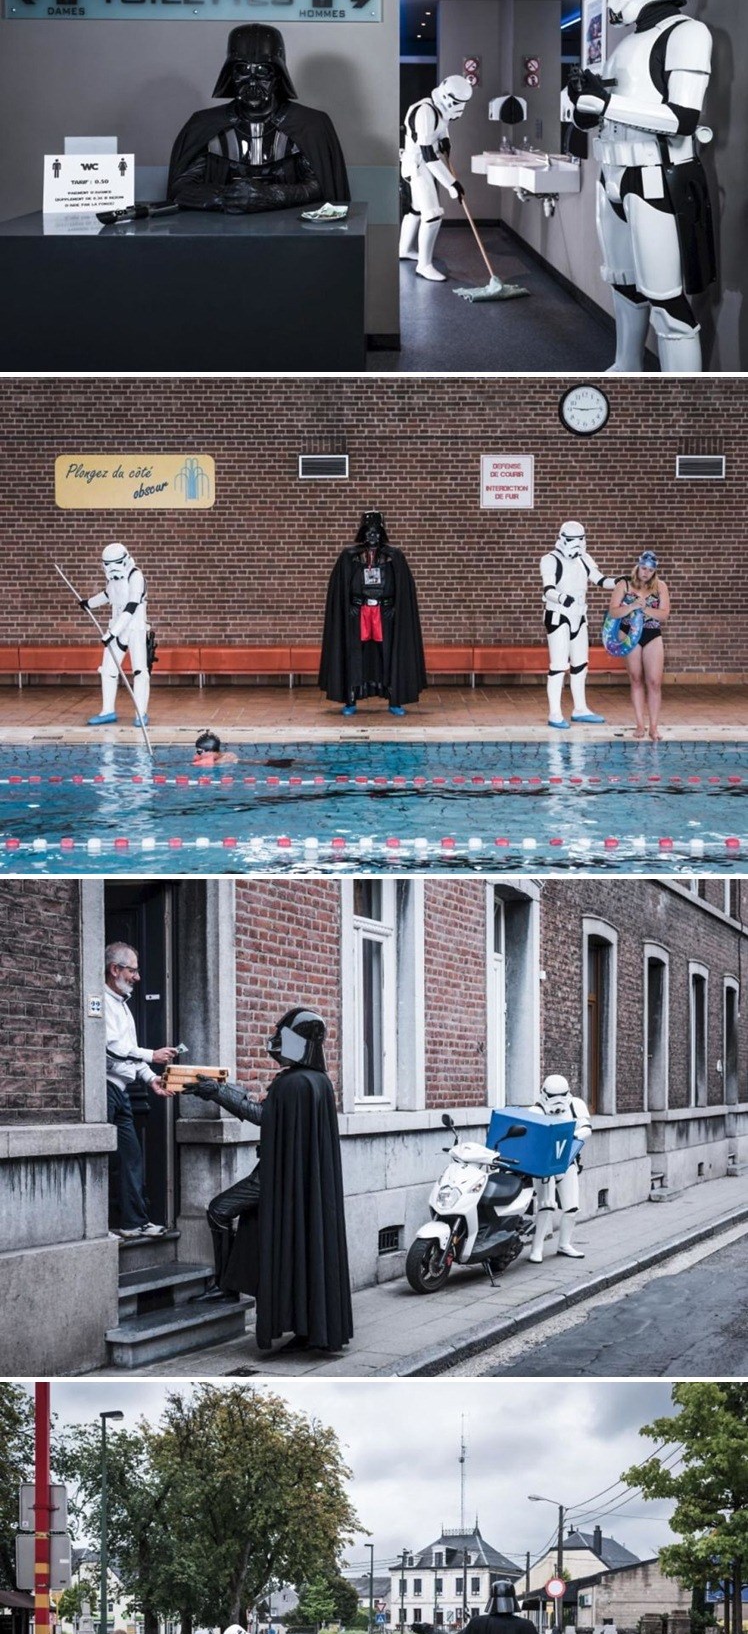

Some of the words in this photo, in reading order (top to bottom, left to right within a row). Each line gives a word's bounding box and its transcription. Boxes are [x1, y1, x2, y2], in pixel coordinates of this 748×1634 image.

[47, 7, 86, 16] DAMES
[299, 9, 346, 18] HOMMES
[80, 163, 99, 171] WC
[65, 463, 109, 484] Plongez
[112, 464, 124, 478] du
[128, 465, 154, 478] côté
[133, 480, 169, 499] obscur
